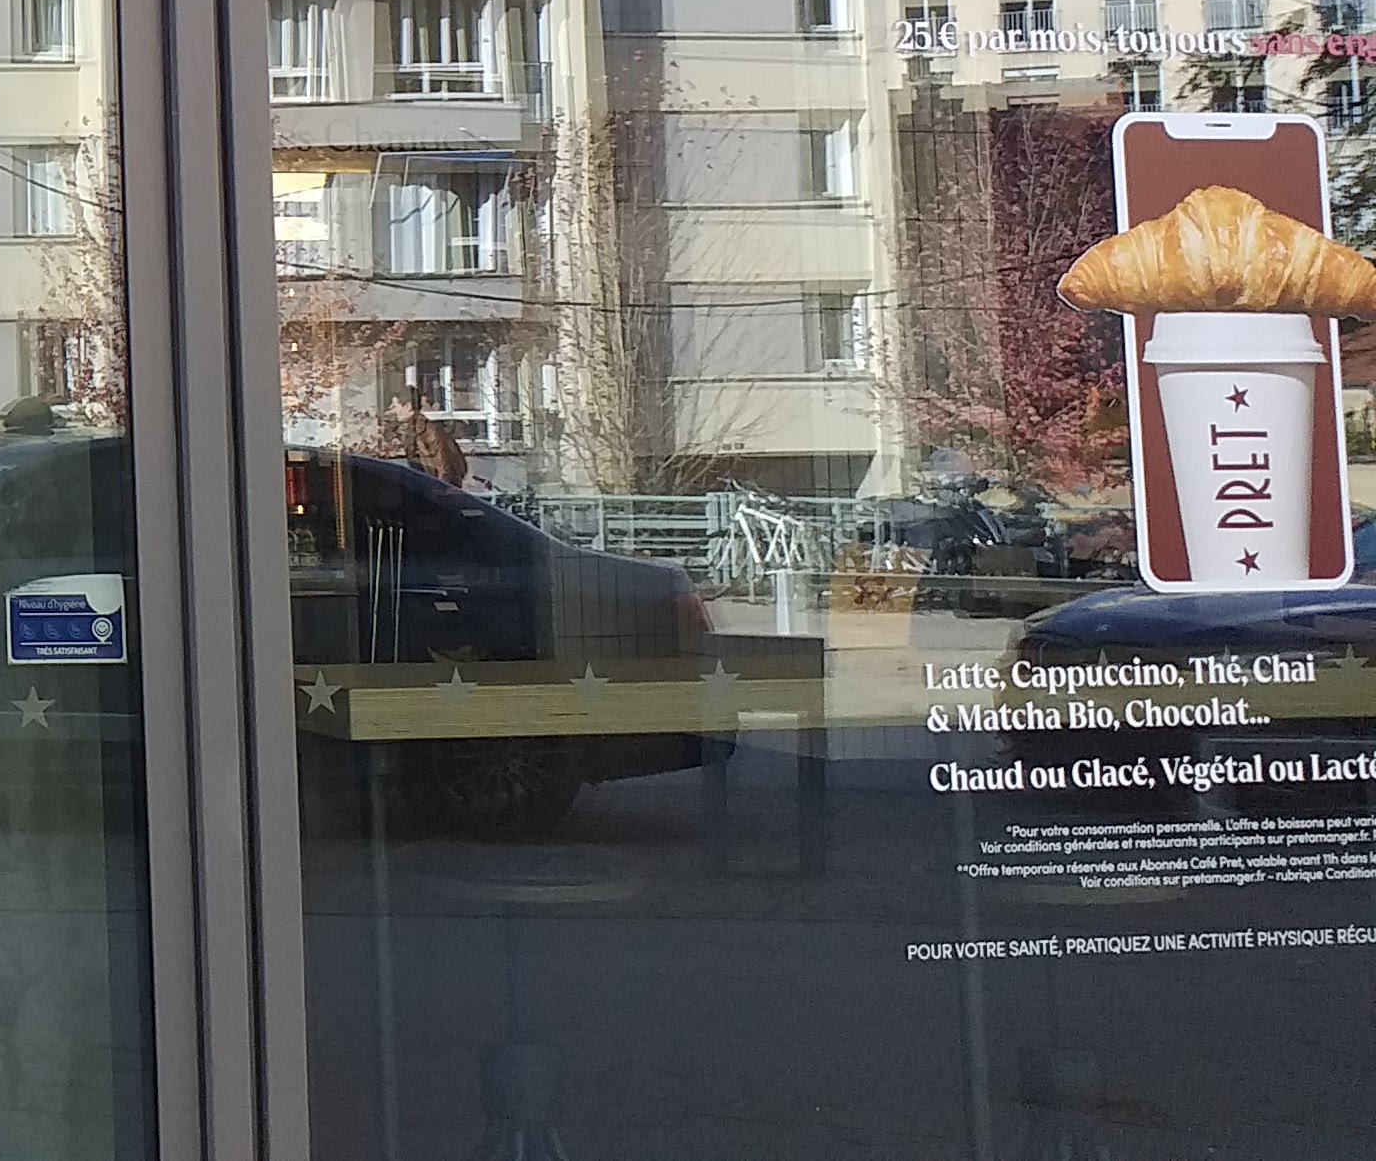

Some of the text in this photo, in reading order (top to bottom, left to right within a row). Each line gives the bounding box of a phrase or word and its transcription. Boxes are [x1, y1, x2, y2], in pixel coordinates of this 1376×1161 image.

[896, 21, 932, 50] 25
[938, 21, 960, 50] €
[967, 28, 1022, 57] par
[1028, 22, 1109, 55] mois,
[1114, 24, 1248, 60] toujours
[1249, 33, 1324, 57] sans
[1209, 422, 1275, 530] PRET
[18, 599, 47, 609] Niveau
[924, 653, 1317, 696] Latte, Cappuccino, Thé, Chai
[926, 696, 1271, 733] & Matcha Bio, Chocolat...
[929, 759, 1025, 792] Chaud
[1029, 765, 1066, 789] ou
[1071, 756, 1156, 789] Glacé,
[1159, 753, 1265, 793] Végétal
[1269, 758, 1305, 782] ou
[1040, 824, 1070, 837] votre
[1071, 822, 1155, 837] consommation
[1156, 818, 1224, 836] personnelle.
[1225, 816, 1259, 832] L'offre
[1260, 816, 1276, 830] de
[1277, 816, 1325, 830] boissons
[1326, 815, 1352, 831] peut
[980, 841, 1003, 854] Voir
[1004, 840, 1062, 853] conditions
[1064, 838, 1120, 855] générales
[1121, 838, 1134, 850] et
[1135, 835, 1198, 851] restaurants
[1200, 833, 1266, 850] participants
[1267, 834, 1284, 846] sur
[1001, 861, 1064, 878] temporaire
[1066, 861, 1115, 874] réservée
[1117, 860, 1138, 872] aux
[1139, 857, 1189, 872] Abonnés
[1190, 855, 1218, 870] Café
[1219, 855, 1245, 870] Pret,
[1246, 854, 1287, 868] valable
[1289, 854, 1321, 867] avant
[1322, 852, 1340, 866] 11h
[1340, 851, 1368, 865] dans
[1079, 875, 1101, 888] Voir
[1103, 874, 1161, 887] conditions
[1162, 875, 1180, 886] sur
[1181, 869, 1266, 888] pretamanger.fr
[1275, 868, 1324, 884] rubrique
[906, 942, 953, 961] POUR
[954, 941, 1007, 959] VOTRE
[1008, 934, 1063, 958] SANTÉ,
[1065, 934, 1152, 955] PRATIQUEZ
[1153, 934, 1187, 951] UNE
[1187, 927, 1255, 950] ACTIVITÉ
[1257, 928, 1335, 947] PHYSIQUE
